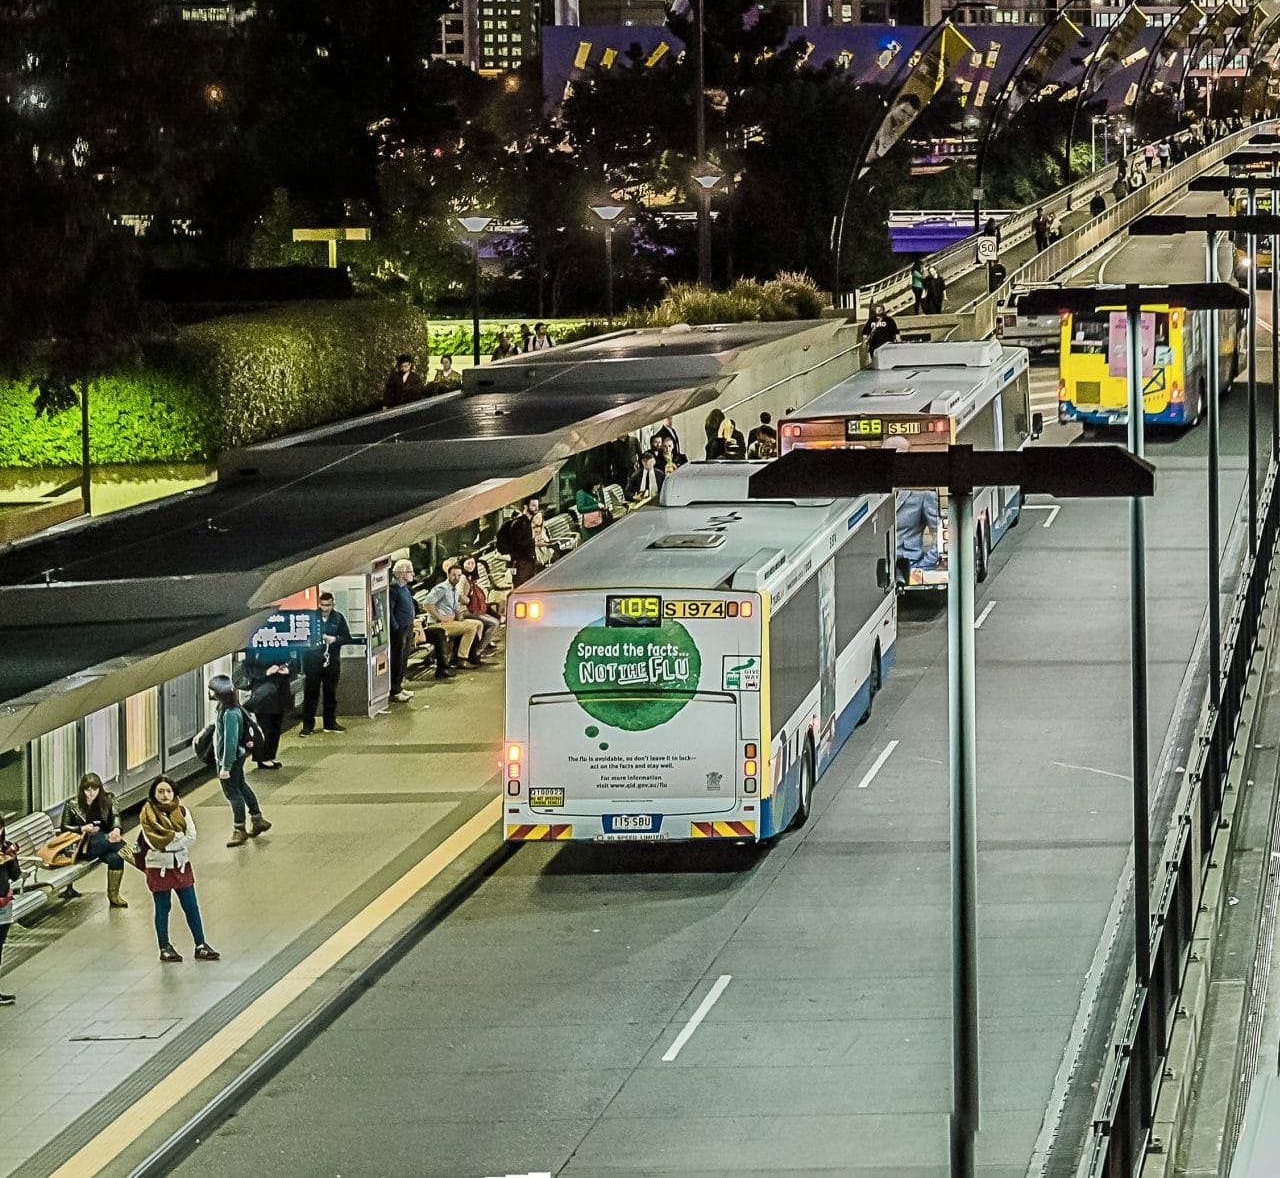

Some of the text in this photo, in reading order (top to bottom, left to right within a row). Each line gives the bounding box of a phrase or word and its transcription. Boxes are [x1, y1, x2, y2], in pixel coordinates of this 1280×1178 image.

[981, 243, 994, 253] 50
[859, 420, 882, 434] 66
[621, 597, 658, 617] 105
[665, 602, 724, 617] S 1974
[577, 643, 690, 659] Spread the facts...
[579, 656, 690, 684] NOT THE FLU
